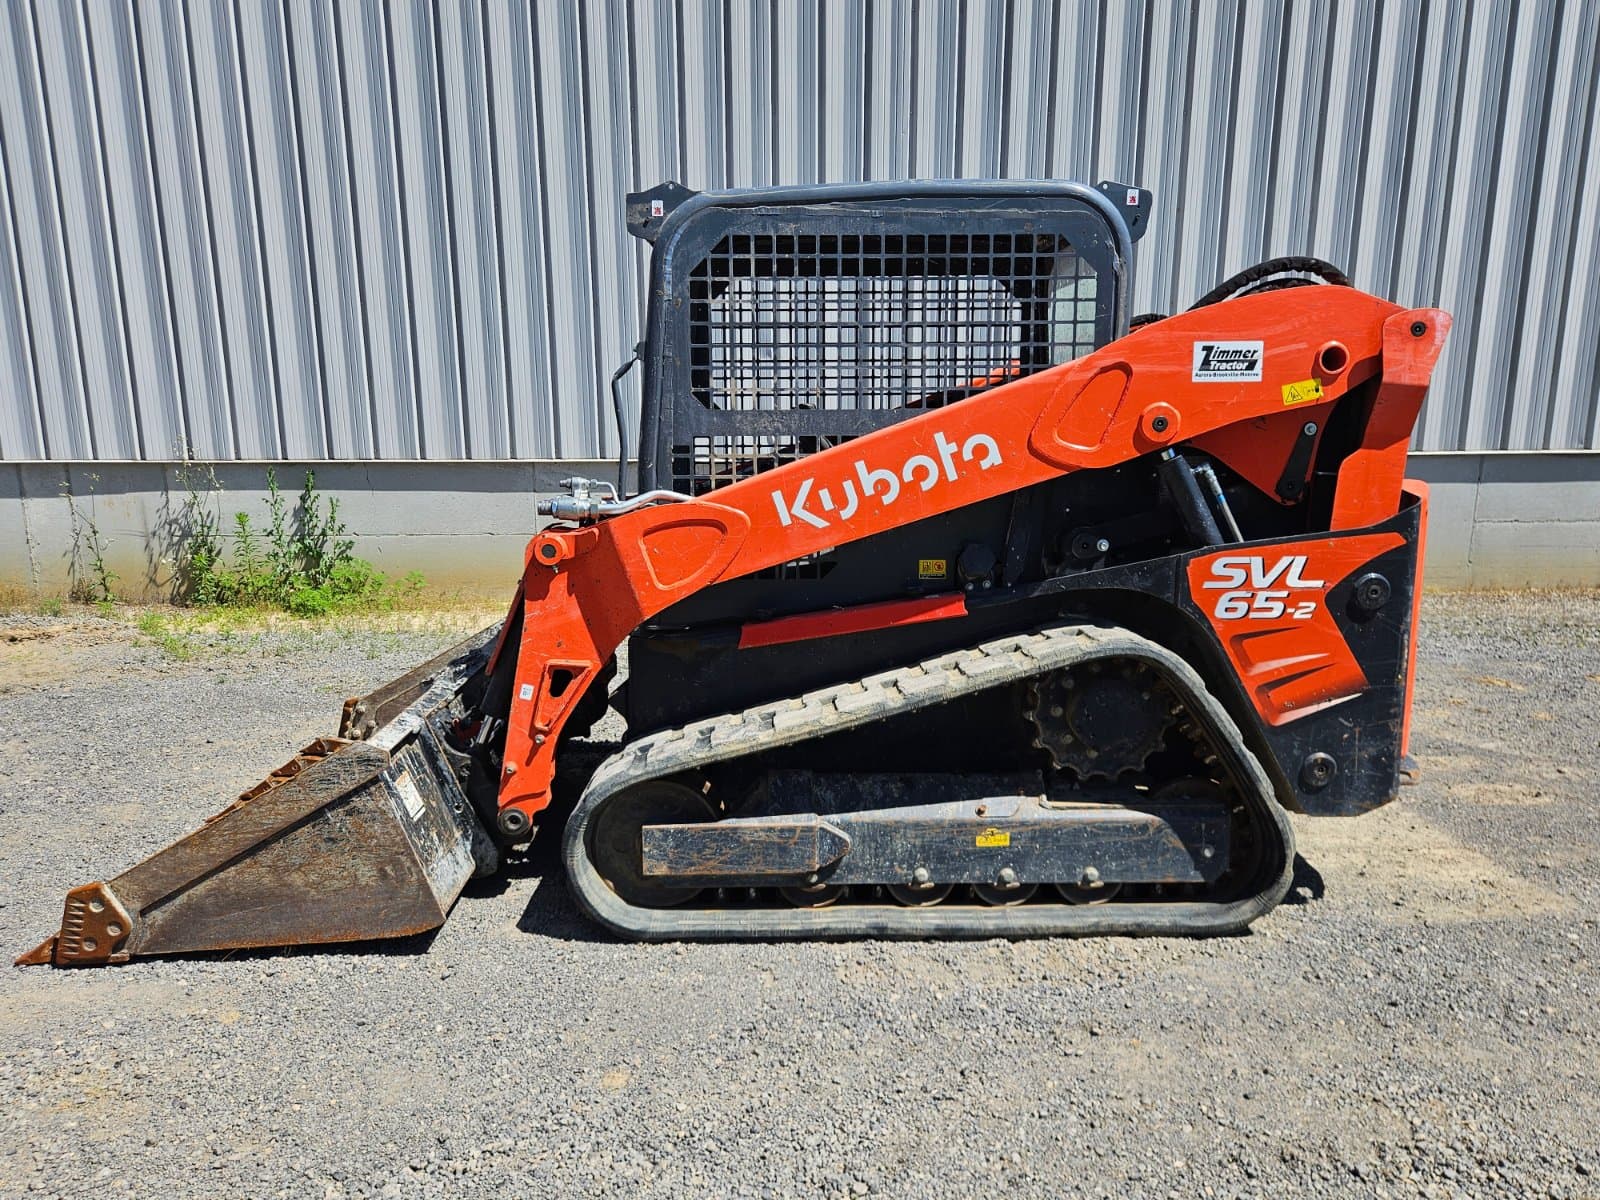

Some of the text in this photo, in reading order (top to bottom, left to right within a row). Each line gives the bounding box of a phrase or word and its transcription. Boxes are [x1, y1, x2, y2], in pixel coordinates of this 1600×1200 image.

[1199, 345, 1259, 371] Zimmer
[1209, 360, 1249, 370] Tractor
[771, 431, 1003, 528] Kubota
[1202, 555, 1325, 589] SVL
[1214, 590, 1317, 619] 65-2
